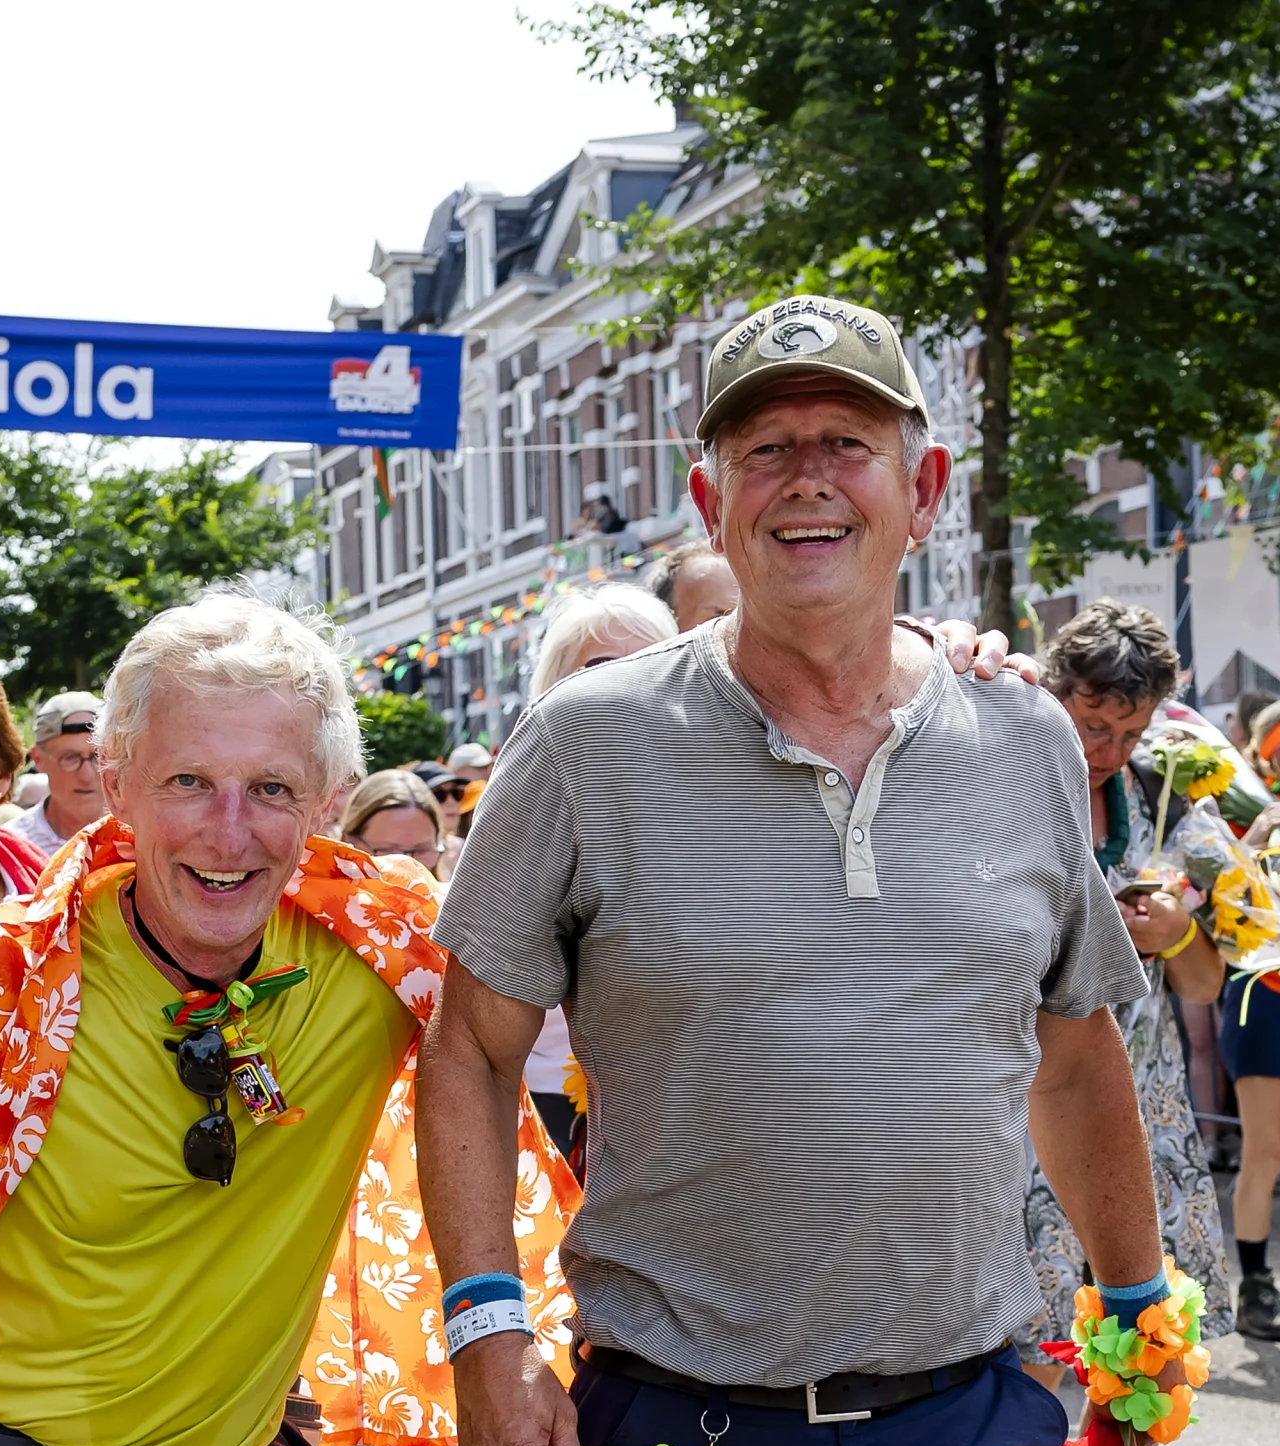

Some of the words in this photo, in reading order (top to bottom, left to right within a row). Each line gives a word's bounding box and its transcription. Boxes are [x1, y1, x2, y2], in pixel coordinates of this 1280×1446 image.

[721, 314, 768, 364] NEW
[771, 300, 882, 346] ZEALAND
[366, 345, 414, 394] 4
